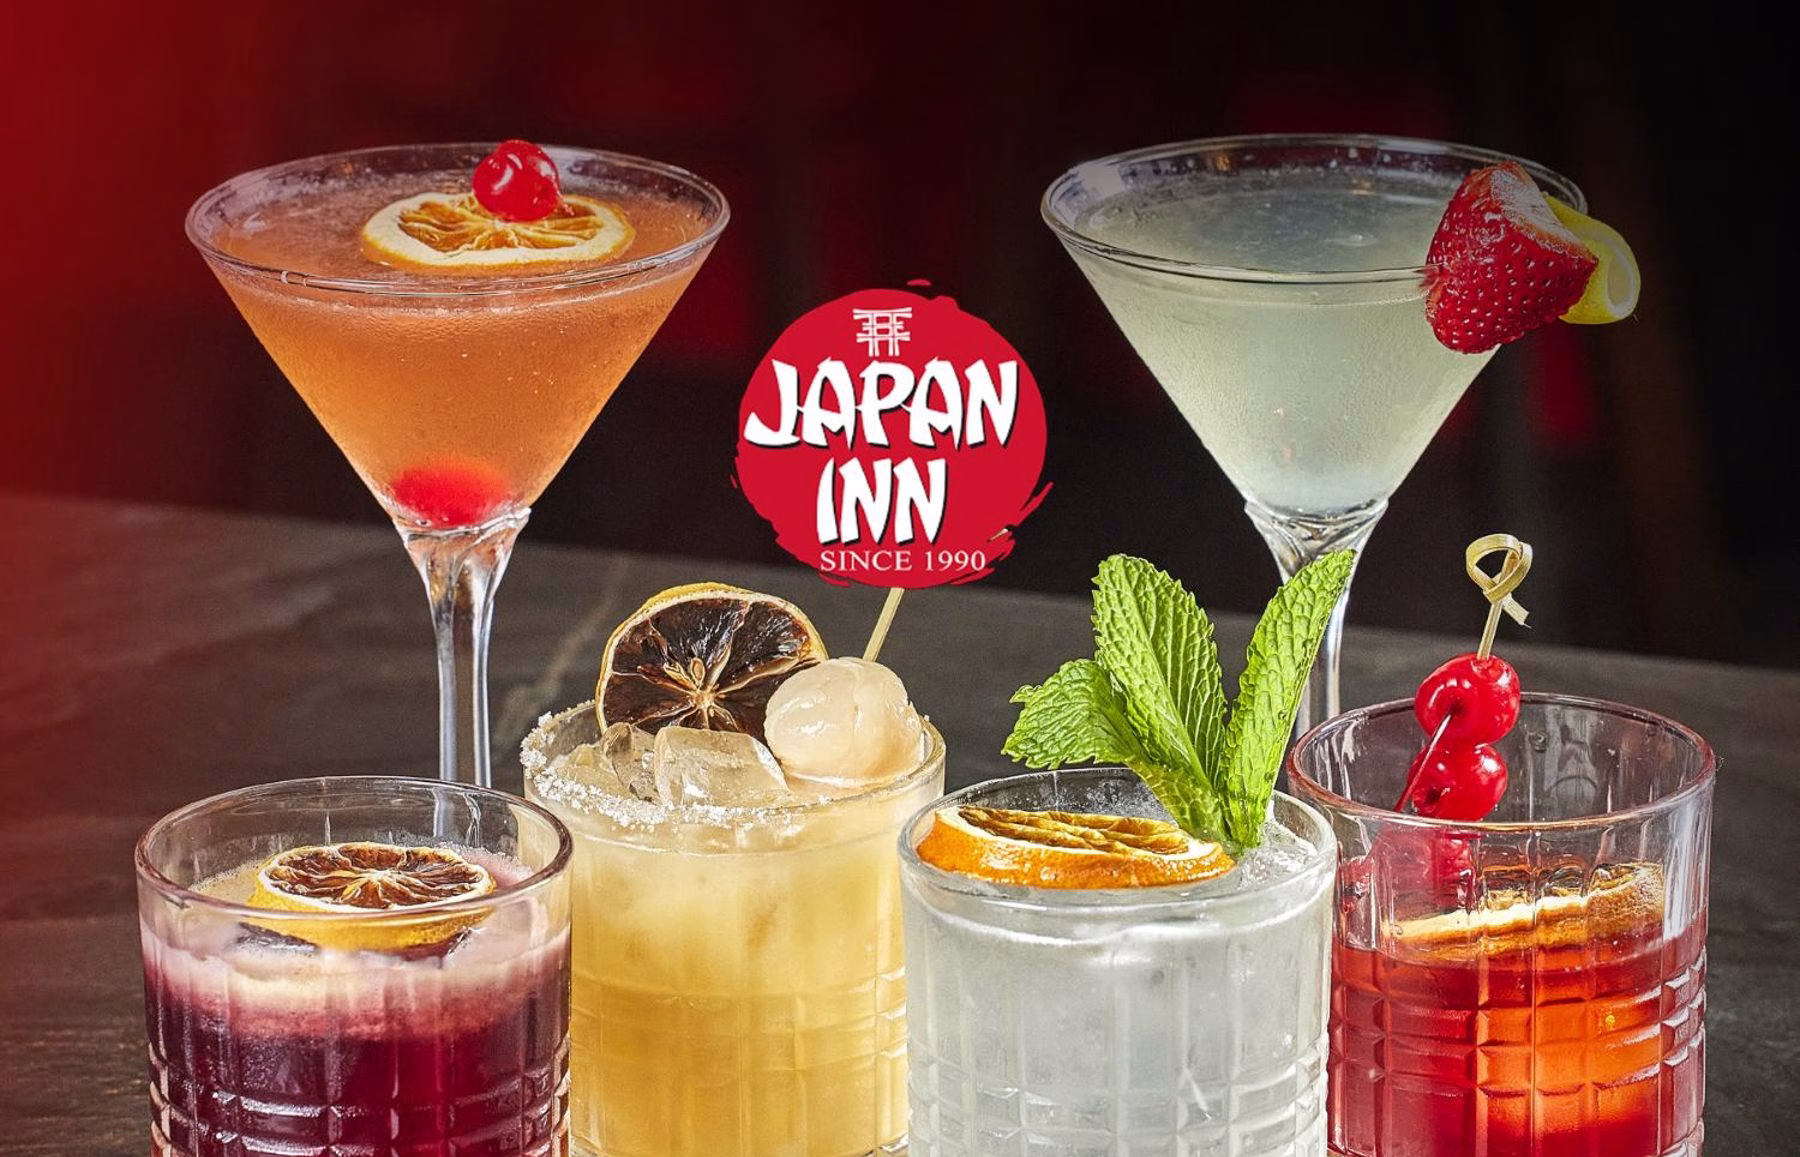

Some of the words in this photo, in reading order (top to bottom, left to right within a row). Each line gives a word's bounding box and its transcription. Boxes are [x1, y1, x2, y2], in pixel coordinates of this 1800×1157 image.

[743, 356, 1018, 450] JAPAN
[815, 456, 947, 545] INN
[820, 550, 912, 571] SINCE
[925, 550, 986, 571] 1990
